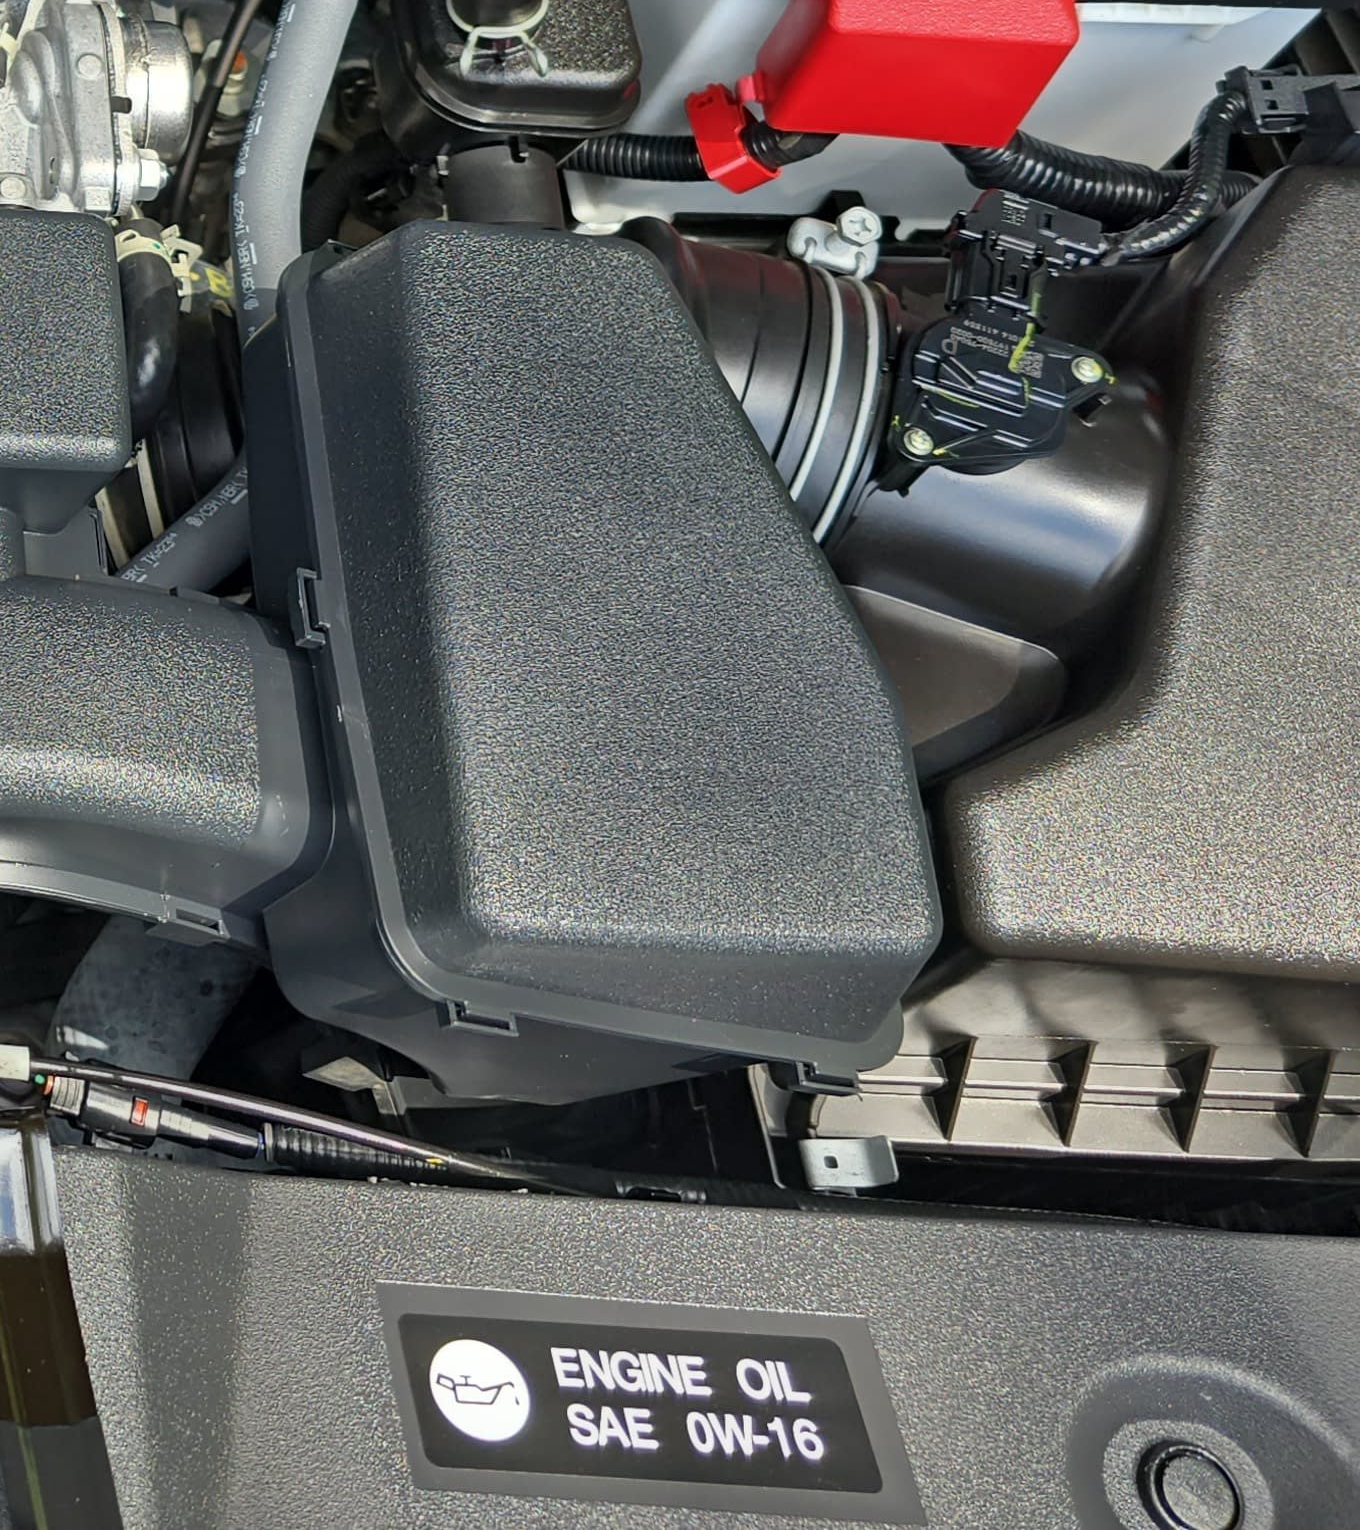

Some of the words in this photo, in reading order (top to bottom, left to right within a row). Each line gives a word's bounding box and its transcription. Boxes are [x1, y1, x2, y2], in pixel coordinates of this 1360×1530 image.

[549, 1347, 710, 1398] ENGINE
[734, 1358, 812, 1404] OIL
[567, 1405, 660, 1450] SAE
[687, 1410, 826, 1461] 0W-16
